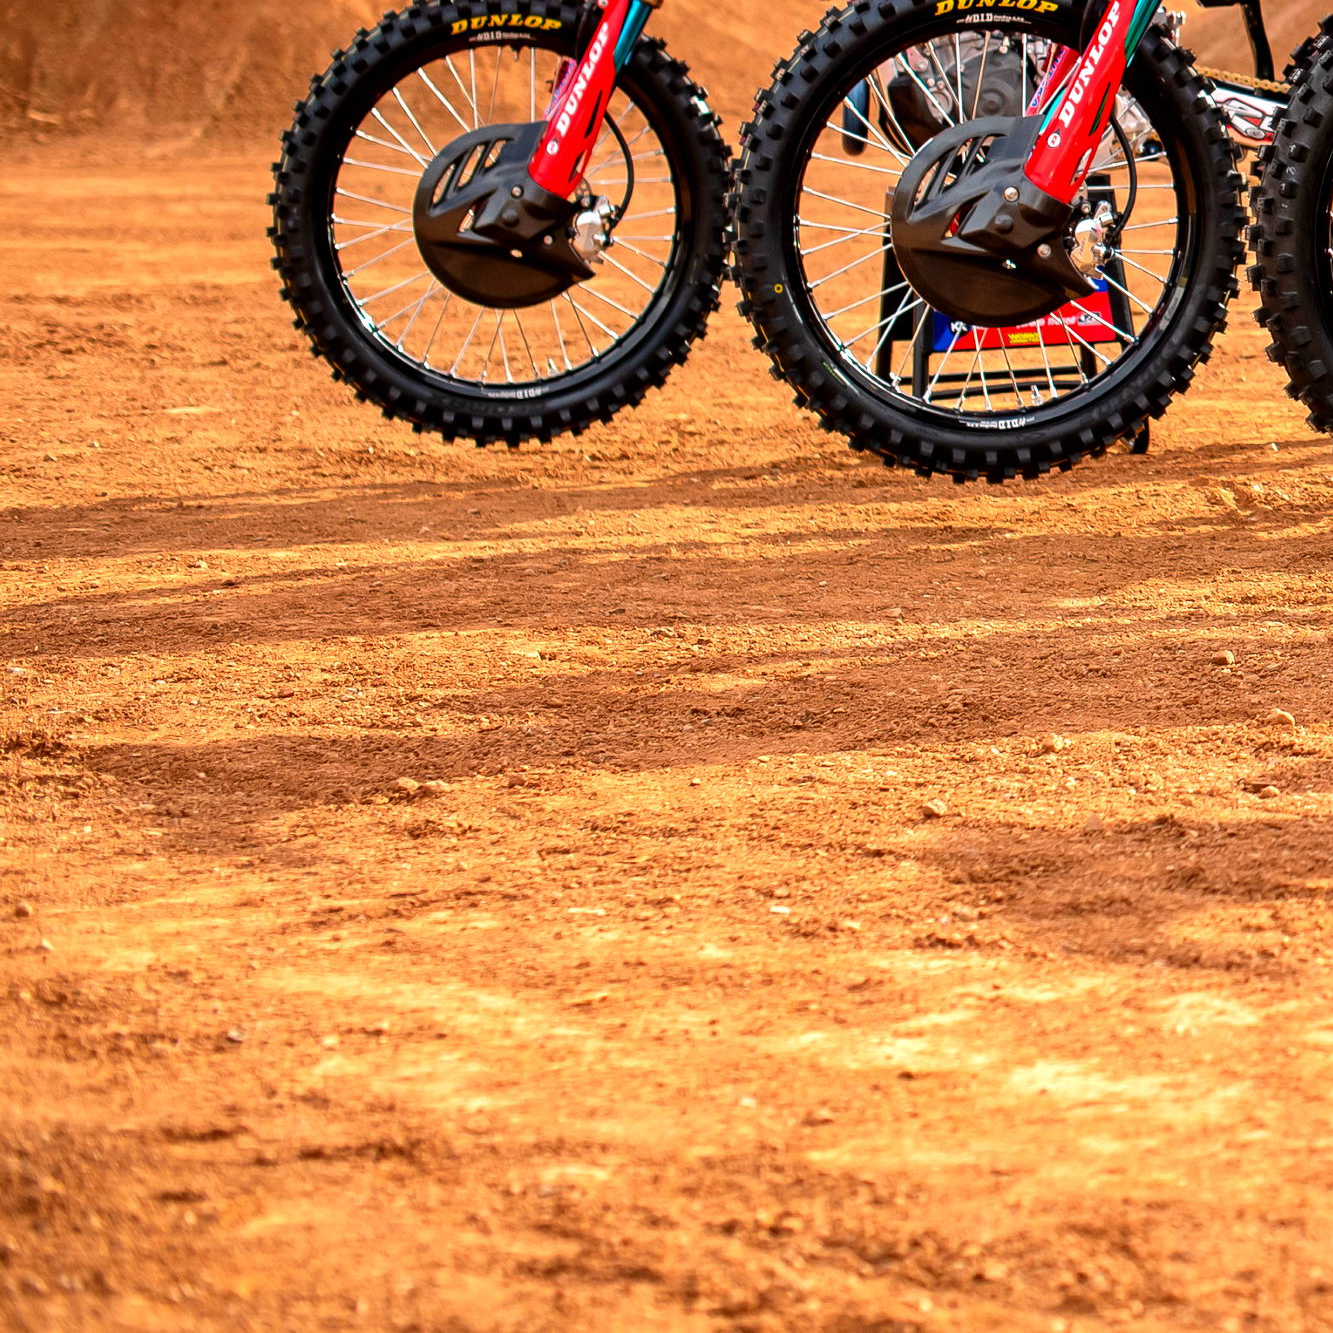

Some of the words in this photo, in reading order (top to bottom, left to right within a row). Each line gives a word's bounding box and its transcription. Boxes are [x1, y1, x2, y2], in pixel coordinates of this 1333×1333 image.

[451, 14, 563, 35] DUNLOP
[555, 22, 609, 138] DUNLOP
[1059, 1, 1121, 129] DUNLOP
